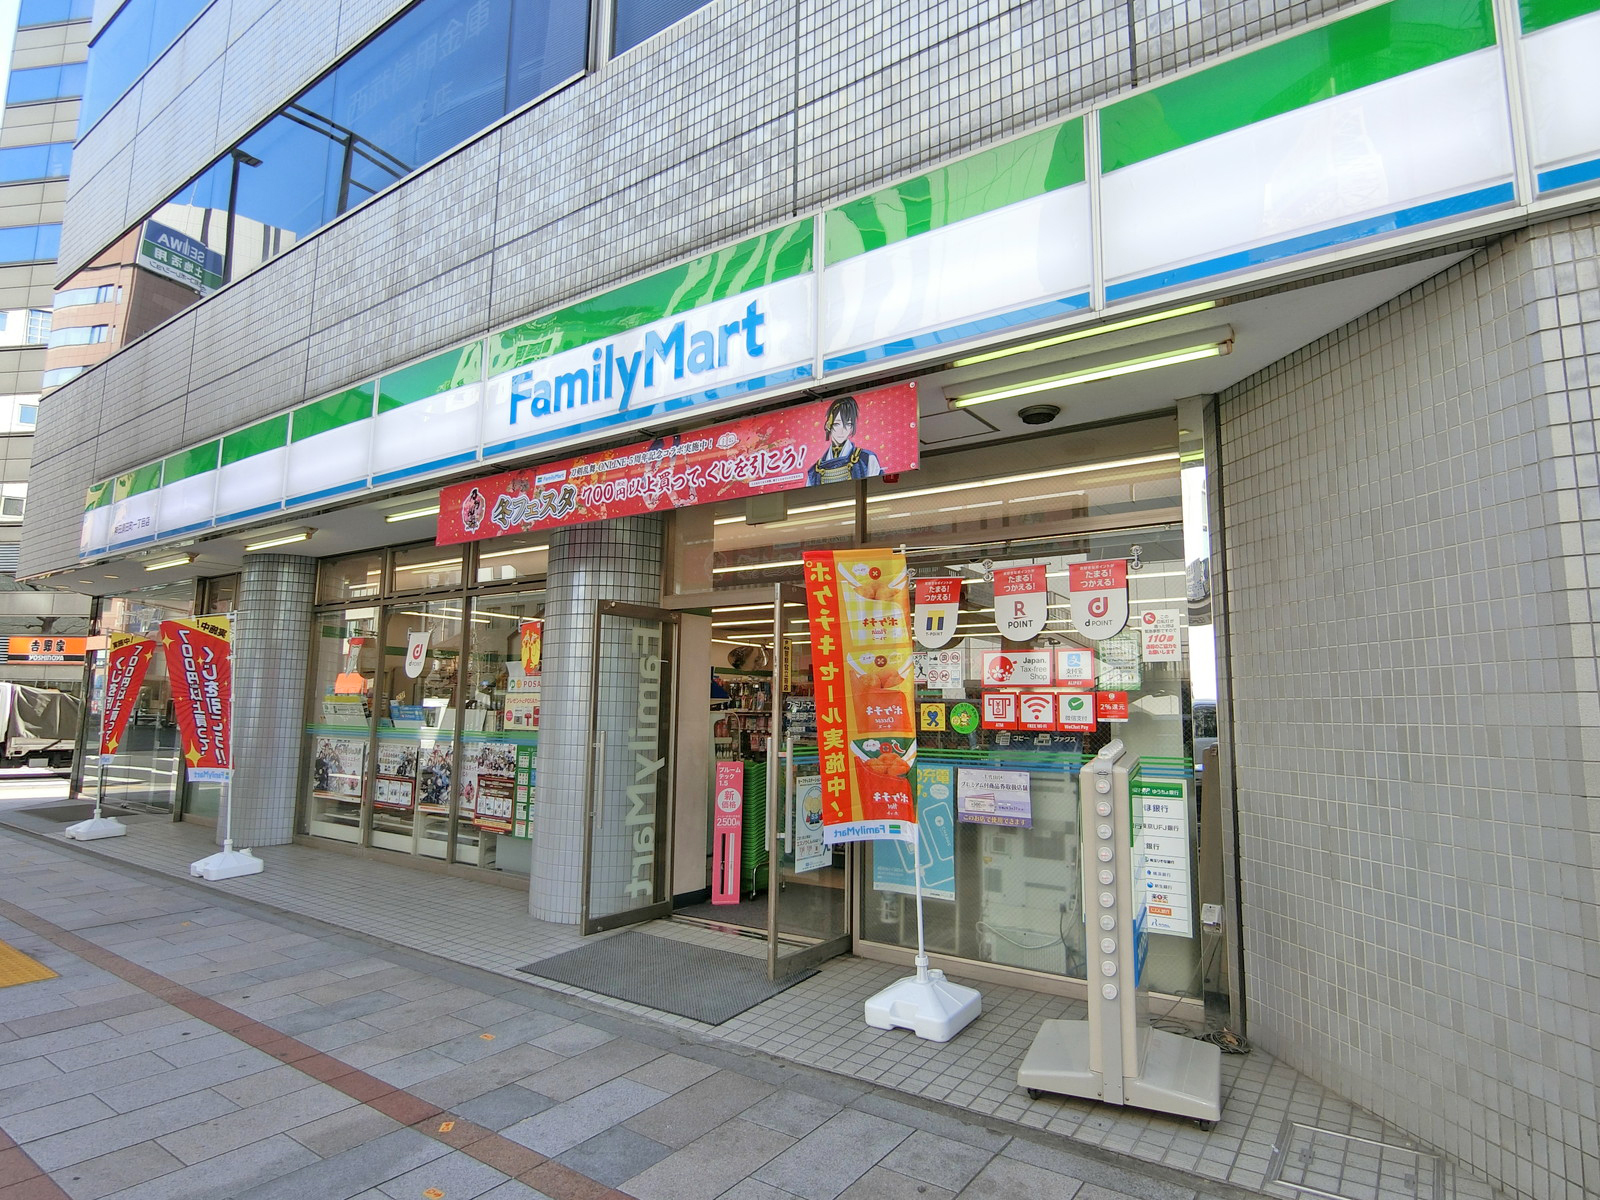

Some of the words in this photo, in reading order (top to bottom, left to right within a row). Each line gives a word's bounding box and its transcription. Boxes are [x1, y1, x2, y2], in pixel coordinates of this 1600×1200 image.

[510, 299, 765, 425] FamilyMart
[543, 473, 565, 483] FamilyMart
[492, 485, 577, 530] 冬フェスタ
[1085, 570, 1112, 578] たまる!
[1008, 575, 1032, 584] たまる!
[1080, 578, 1115, 588] つかえる!
[1004, 584, 1036, 593] つかえる!
[1014, 601, 1026, 616] R
[1007, 620, 1034, 629] POINT
[1085, 619, 1091, 627] d
[1147, 634, 1174, 643] 110番
[31, 640, 66, 652] 吉野家
[1023, 657, 1047, 665] Japan.
[1020, 665, 1047, 673] Tax-free
[1030, 673, 1047, 681] Shop
[724, 790, 735, 800] 新
[721, 801, 737, 809] 価格
[963, 814, 1026, 826] このお店で使用できます
